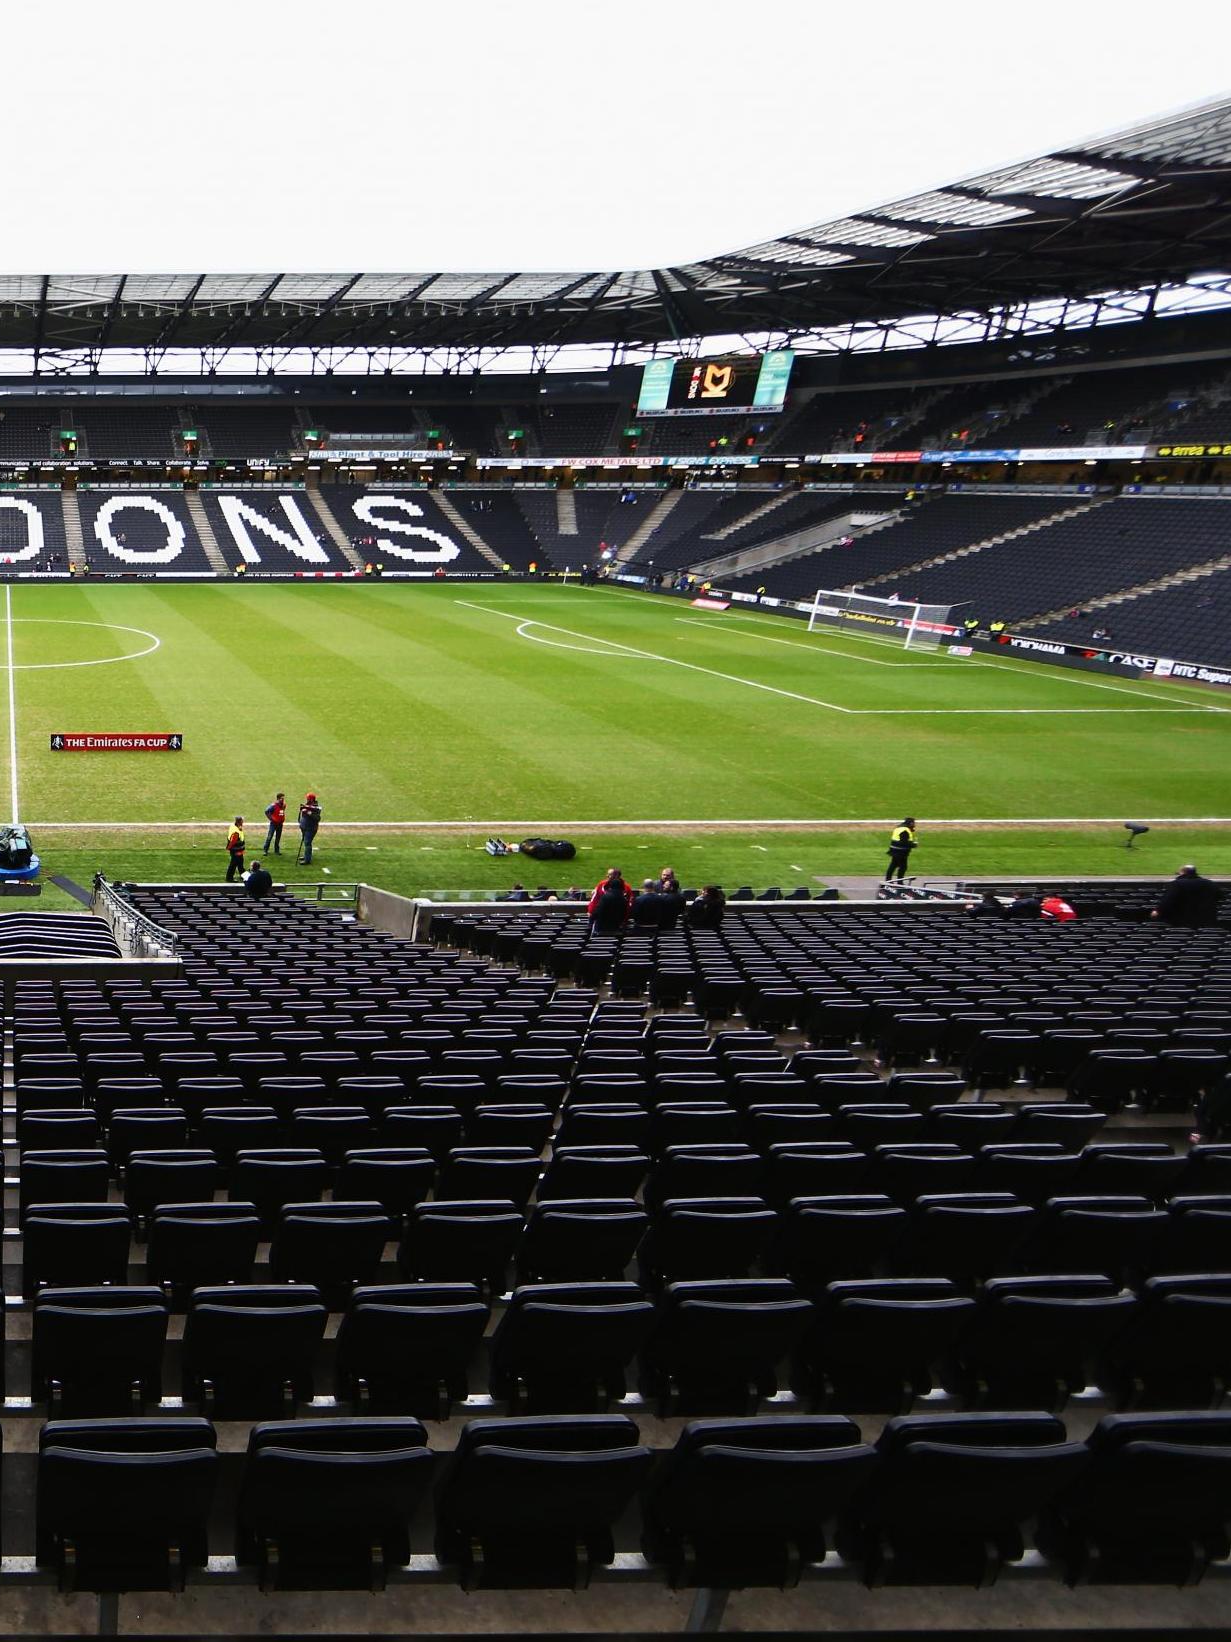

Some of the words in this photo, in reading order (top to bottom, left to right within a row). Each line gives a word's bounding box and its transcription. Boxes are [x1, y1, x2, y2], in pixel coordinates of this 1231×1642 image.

[66, 738, 85, 747] THE
[87, 736, 133, 747] Emirates
[134, 738, 146, 747] FA
[147, 738, 168, 747] CUP
